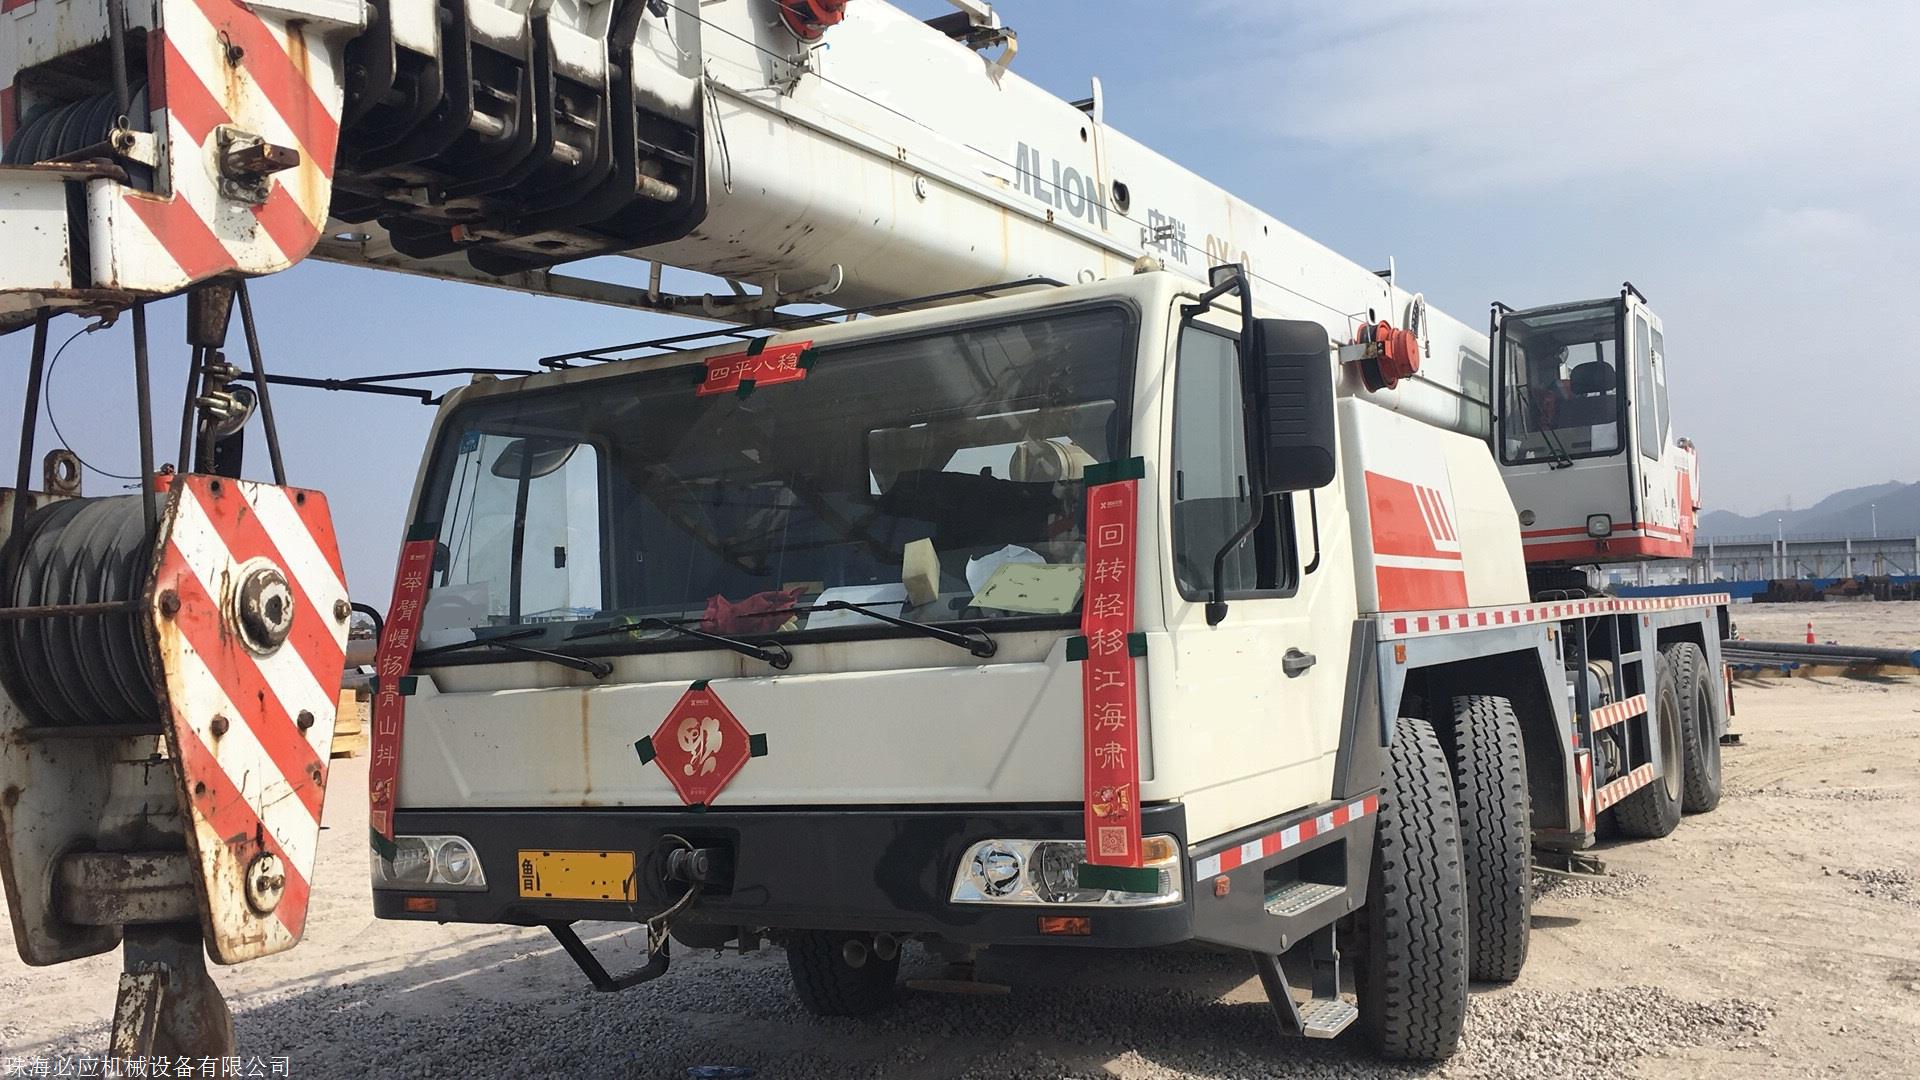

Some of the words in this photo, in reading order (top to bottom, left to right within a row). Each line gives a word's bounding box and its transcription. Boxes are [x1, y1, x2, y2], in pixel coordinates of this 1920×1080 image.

[711, 353, 798, 380] 四平八稳
[376, 571, 422, 766] 举臂慢扬青山抖
[1091, 523, 1127, 769] 回转轻移江海啸
